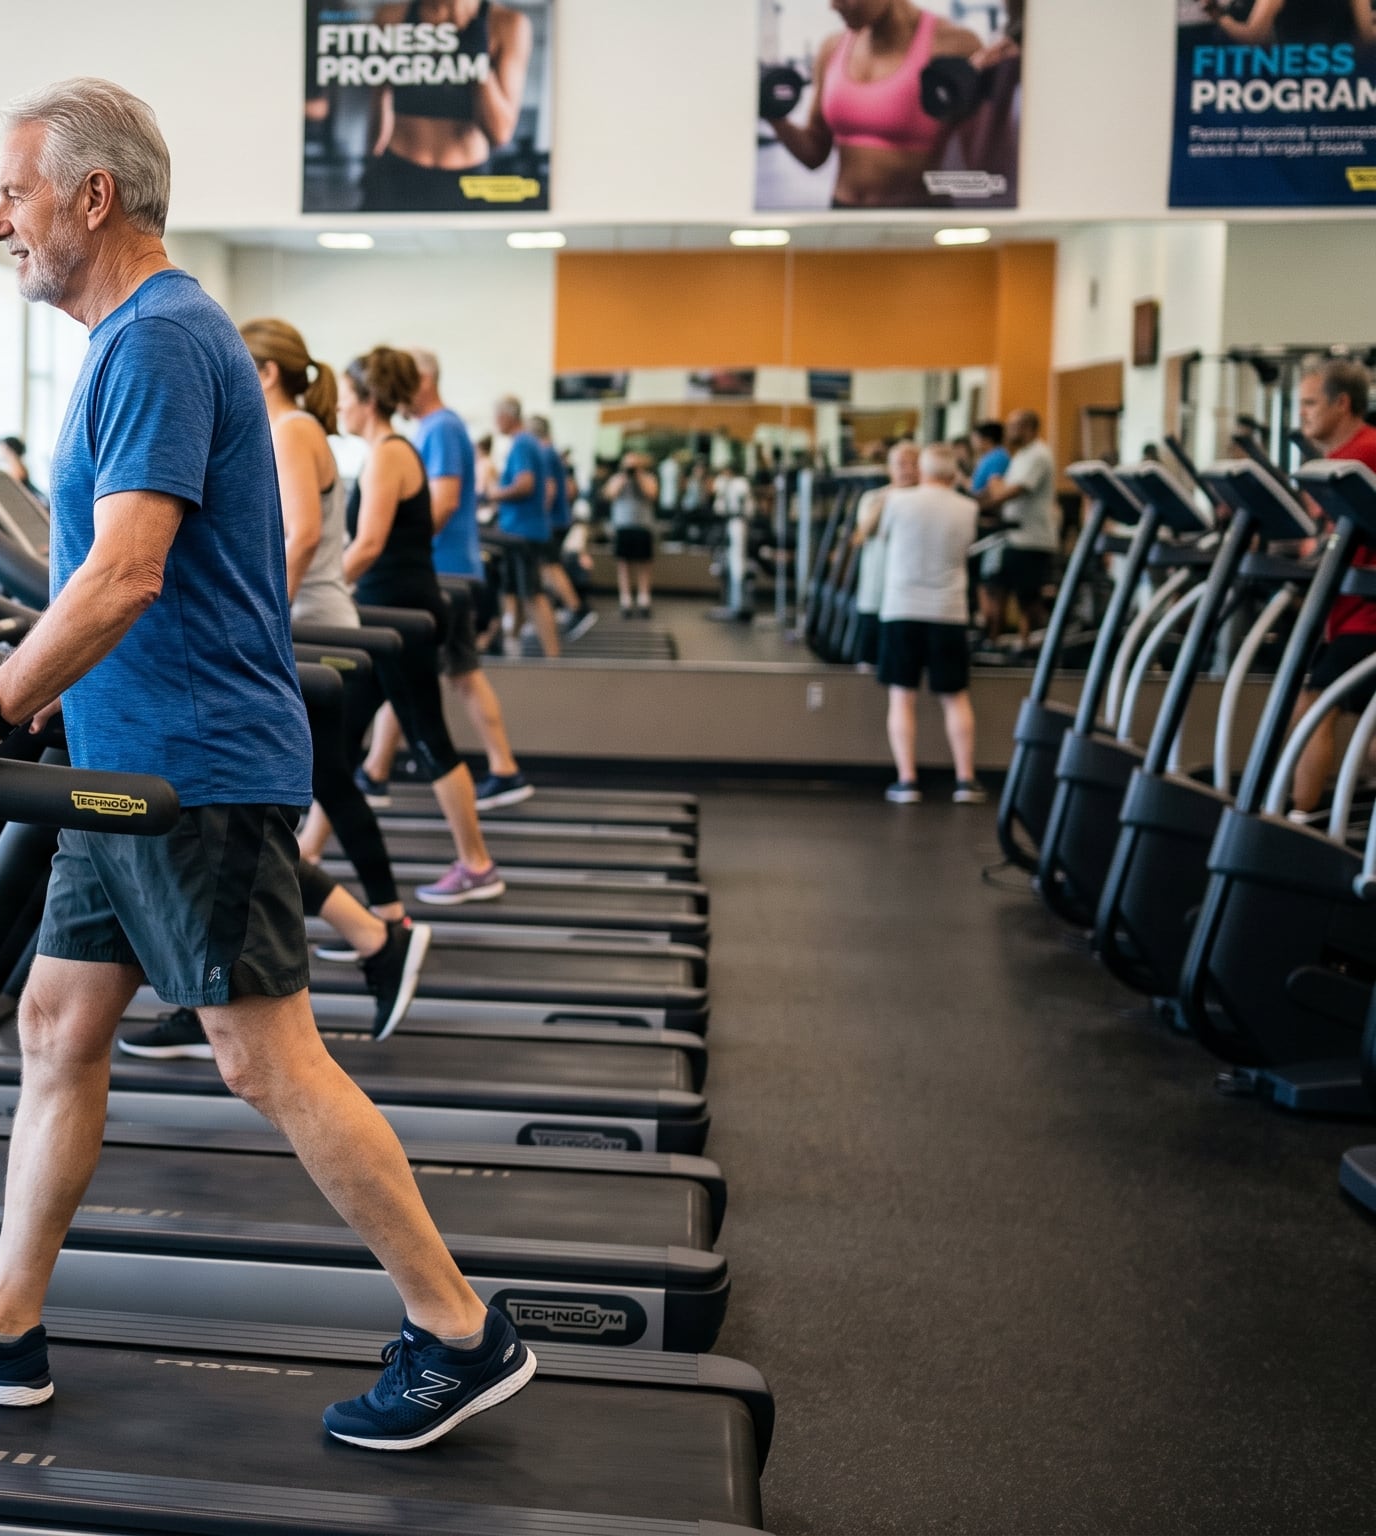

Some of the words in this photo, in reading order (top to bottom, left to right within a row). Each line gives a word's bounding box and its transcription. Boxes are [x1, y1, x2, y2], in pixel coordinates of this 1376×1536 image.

[317, 23, 459, 54] FITNESS
[317, 54, 490, 86] PROGRAM
[1193, 43, 1356, 77] FITNESS
